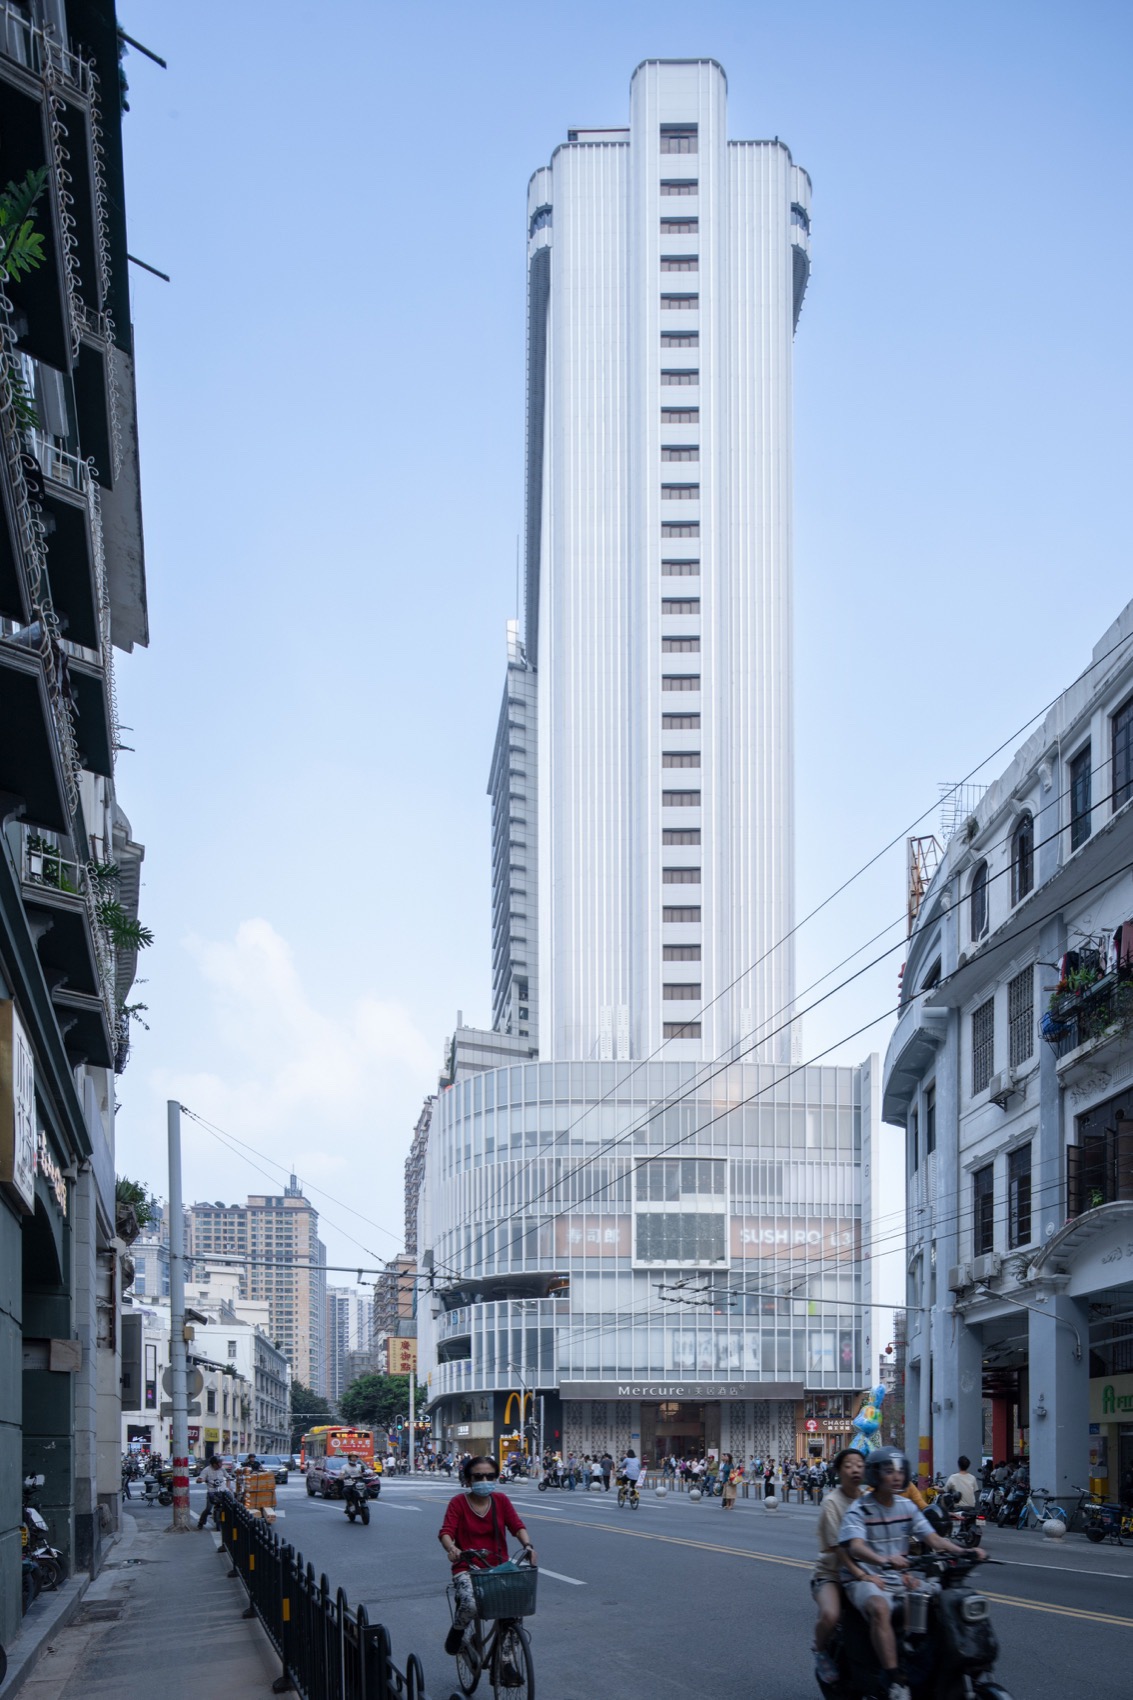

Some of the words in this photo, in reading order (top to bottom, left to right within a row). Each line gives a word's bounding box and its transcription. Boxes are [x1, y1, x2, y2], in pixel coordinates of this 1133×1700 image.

[618, 1386, 685, 1396] Mercure
[695, 1387, 738, 1396] 美居酒店
